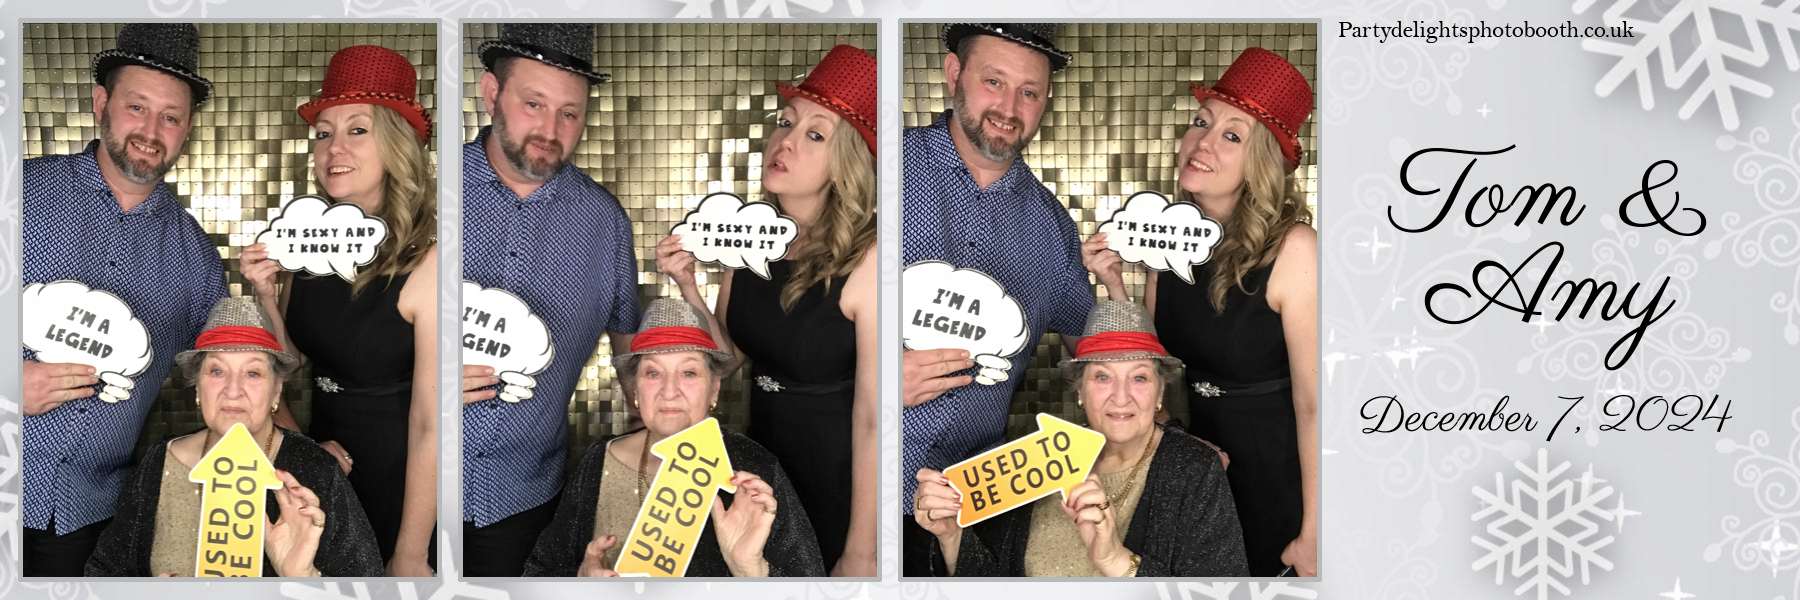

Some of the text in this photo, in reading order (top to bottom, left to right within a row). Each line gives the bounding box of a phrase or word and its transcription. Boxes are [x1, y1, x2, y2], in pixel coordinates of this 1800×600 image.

[276, 227, 376, 238] I'M SEXY AND
[691, 222, 788, 236] I'M SEXY AND
[702, 237, 775, 250] I KNOW IT
[1117, 220, 1212, 238] I'M SEXY AND
[288, 243, 363, 253] I KNOW IT
[1128, 236, 1199, 253] I KNOW IT
[932, 288, 981, 316] I'M A
[66, 306, 110, 335] I'M A
[463, 306, 506, 333] I'M A
[911, 309, 987, 342] LEGEND
[45, 323, 113, 359] LEGEND
[962, 431, 1071, 488] USED TO
[211, 456, 235, 493] TO
[969, 454, 1080, 512] BE COOL
[630, 442, 697, 562] USED TO
[653, 457, 720, 575] BE COOL
[230, 459, 258, 577] E COOL
